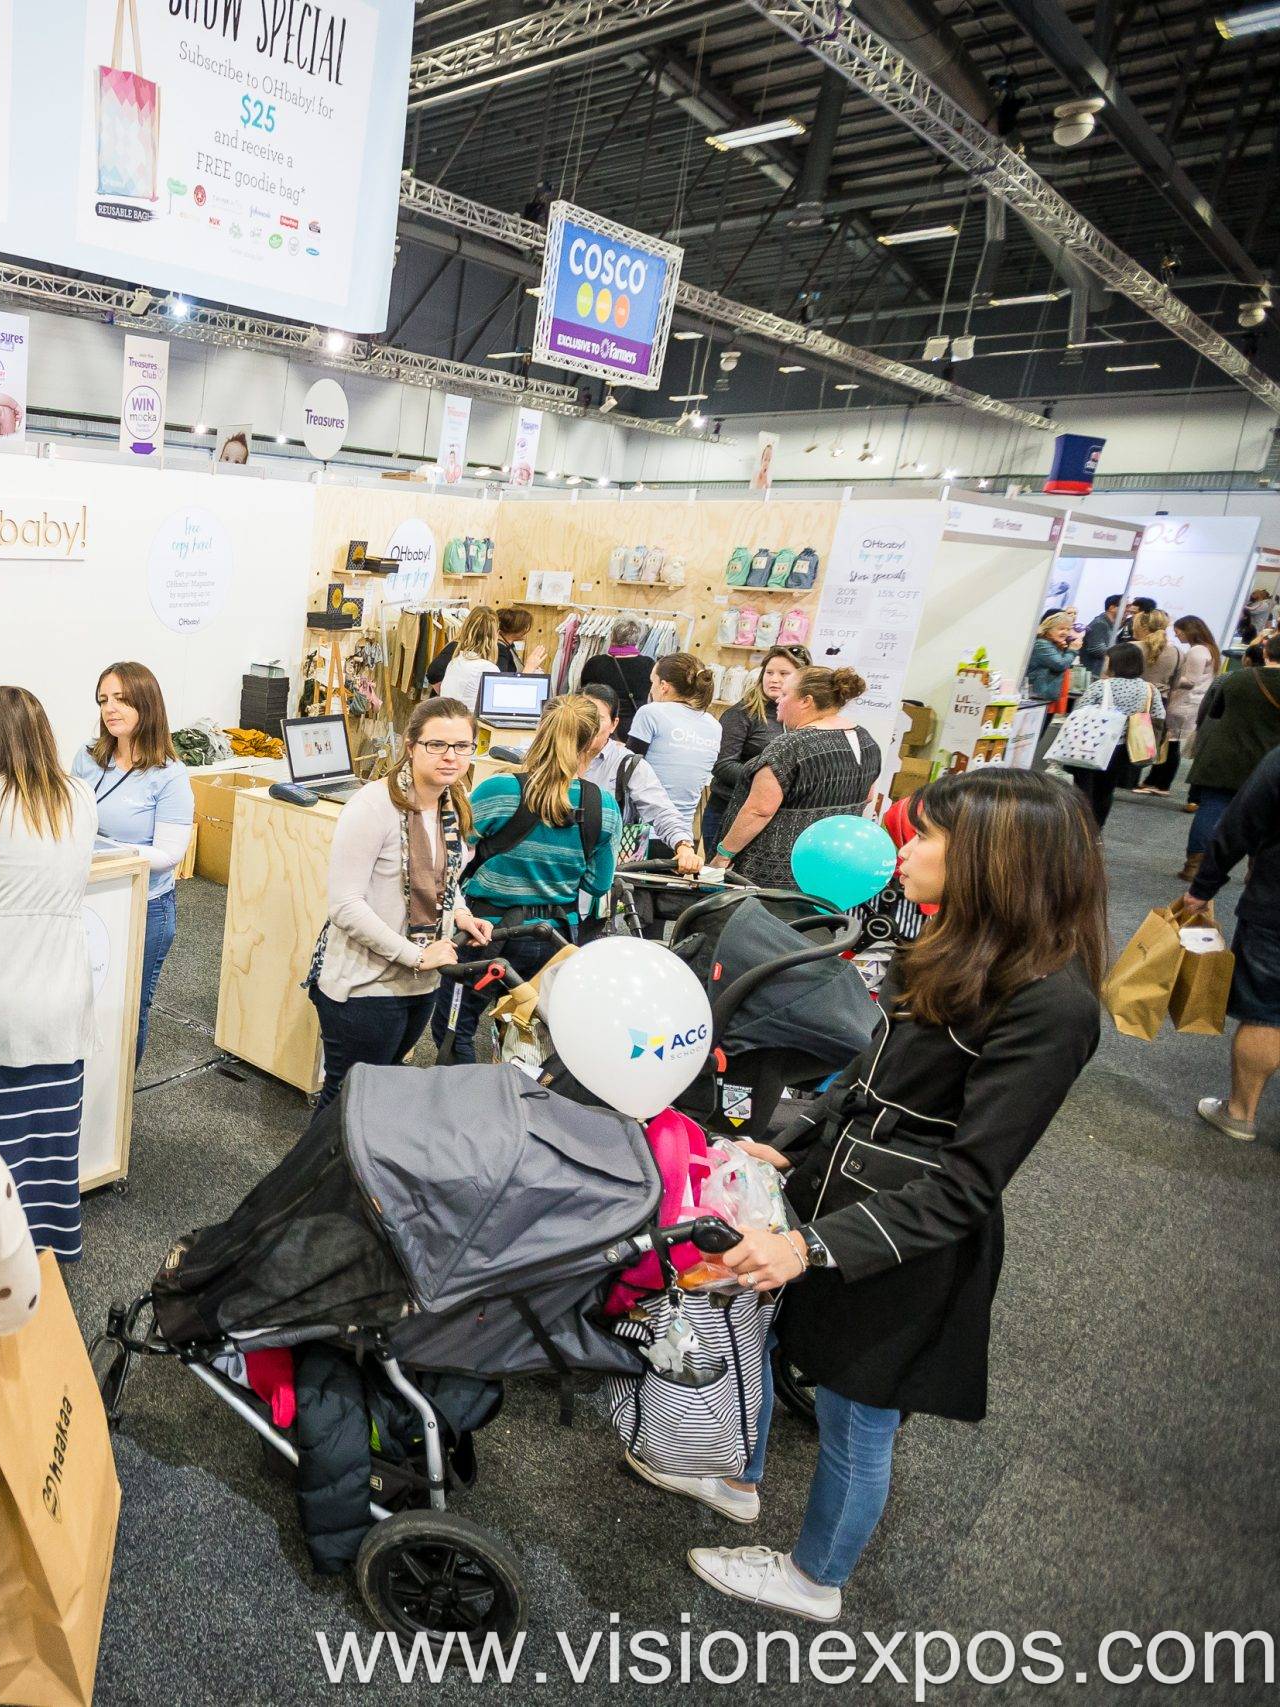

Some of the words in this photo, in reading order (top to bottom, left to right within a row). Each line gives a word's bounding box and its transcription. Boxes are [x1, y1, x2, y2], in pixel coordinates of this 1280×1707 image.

[256, 0, 347, 85] SPECIAL
[179, 40, 244, 83] Subscribe
[246, 72, 258, 89] to
[262, 75, 317, 115] OHbaby!
[319, 96, 334, 120] for
[240, 94, 276, 133] $25
[214, 129, 239, 149] and
[241, 141, 284, 165] receive
[286, 155, 294, 168] a
[196, 151, 232, 180] FREE
[234, 172, 276, 195] goodie
[98, 203, 133, 220] REUSABLE
[570, 237, 646, 295] COSCO
[557, 334, 591, 351] EXCLUSIVE
[592, 343, 601, 356] TO
[609, 341, 637, 365] Farmers
[128, 356, 158, 370] Treasures
[141, 370, 157, 380] Club
[132, 397, 155, 412] WIN
[129, 411, 157, 423] mocka
[305, 408, 345, 429] Treasures
[391, 545, 431, 563] OHbaby!
[834, 597, 856, 606] OFF
[897, 591, 920, 599] OFF
[837, 629, 859, 638] OFF
[875, 641, 898, 650] OFF
[954, 704, 980, 717] BITES
[671, 1023, 708, 1050] ACG
[49, 1396, 74, 1484] haakaa
